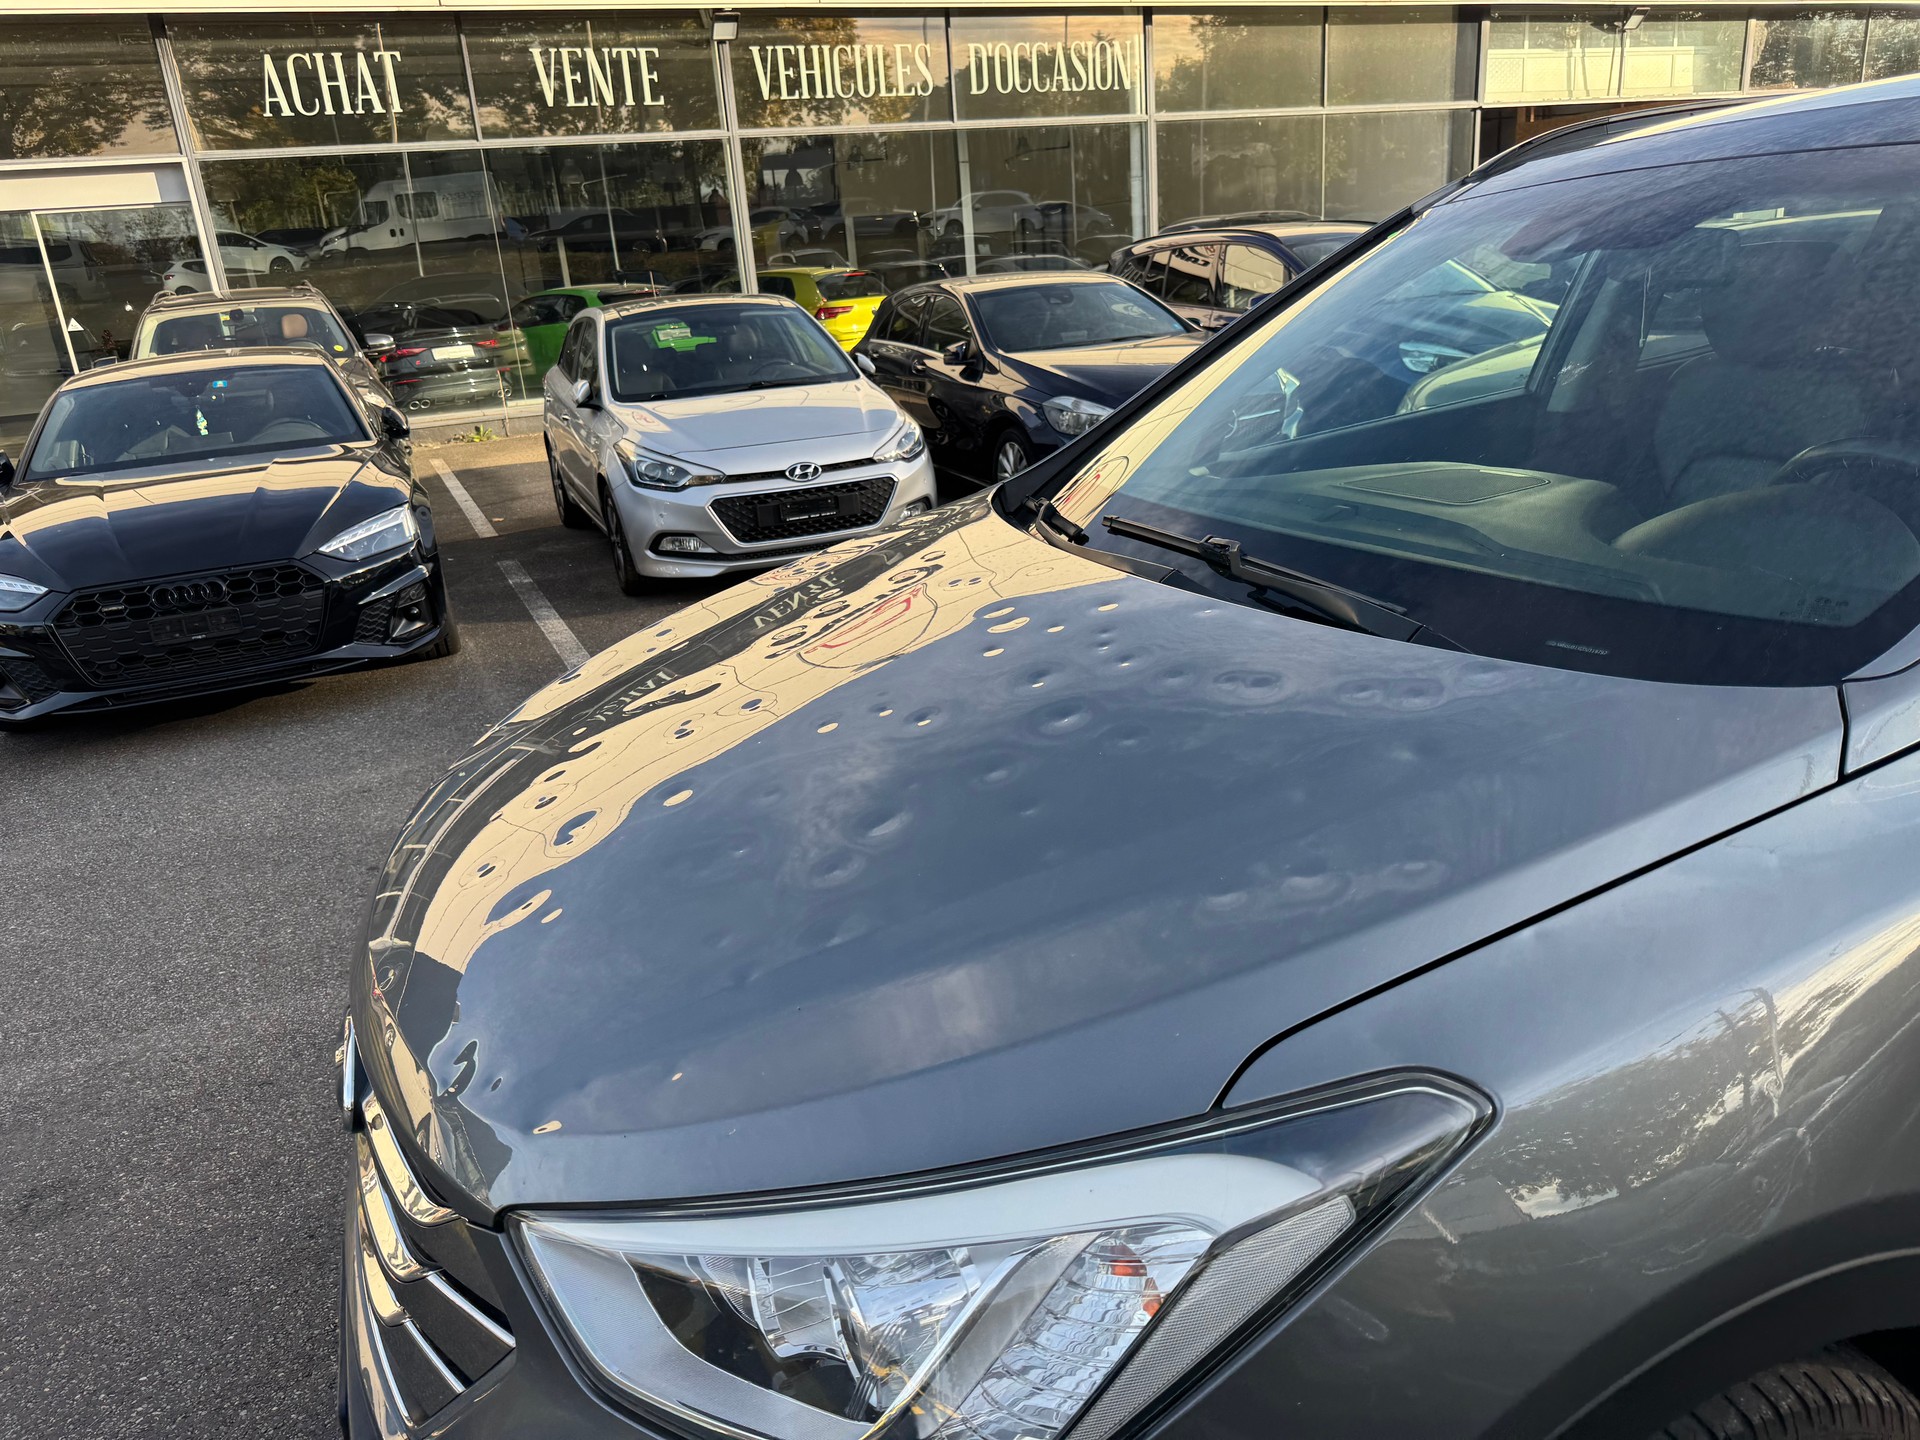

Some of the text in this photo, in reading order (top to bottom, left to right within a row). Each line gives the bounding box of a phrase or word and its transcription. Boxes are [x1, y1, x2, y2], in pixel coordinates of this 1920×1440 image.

[263, 40, 1132, 117] ACHAT VENTE VEHICULES D'OCCASION
